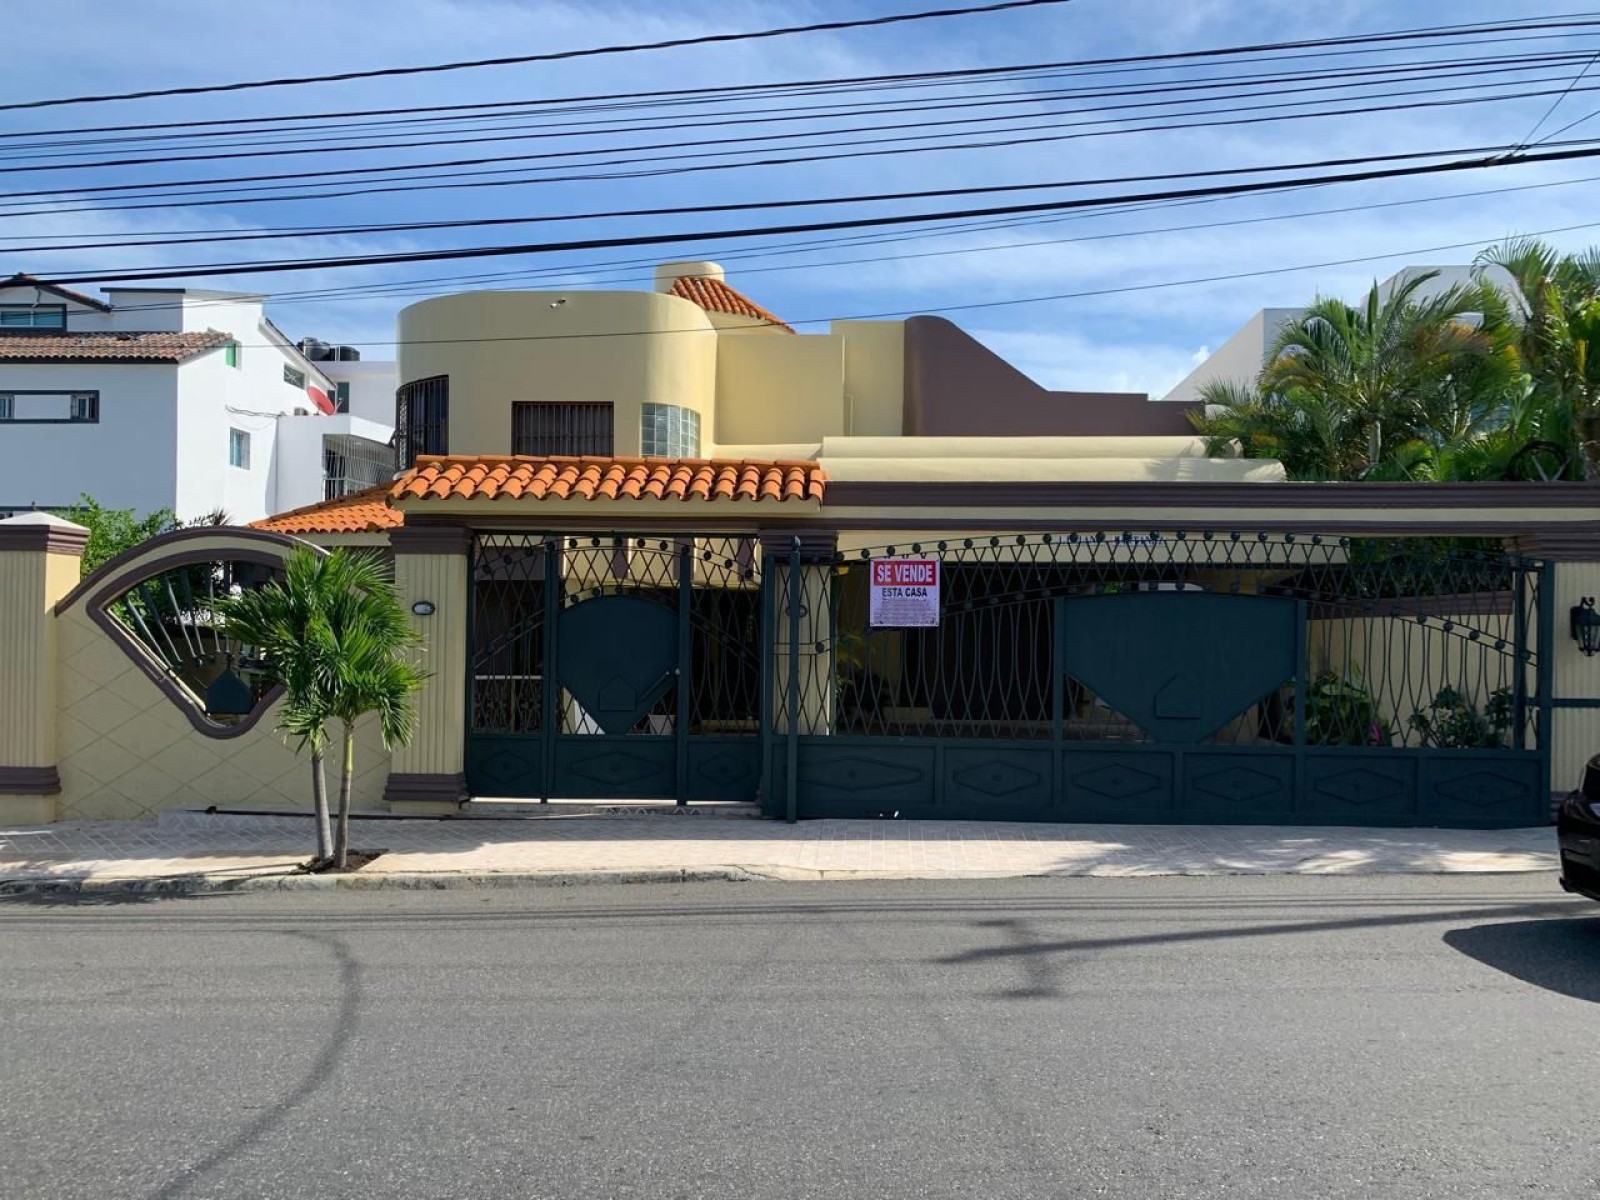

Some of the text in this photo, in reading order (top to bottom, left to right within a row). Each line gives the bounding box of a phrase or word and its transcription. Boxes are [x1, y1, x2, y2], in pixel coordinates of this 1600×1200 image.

[877, 564, 933, 582] SE VENDE
[882, 587, 927, 597] ESTA CASA
